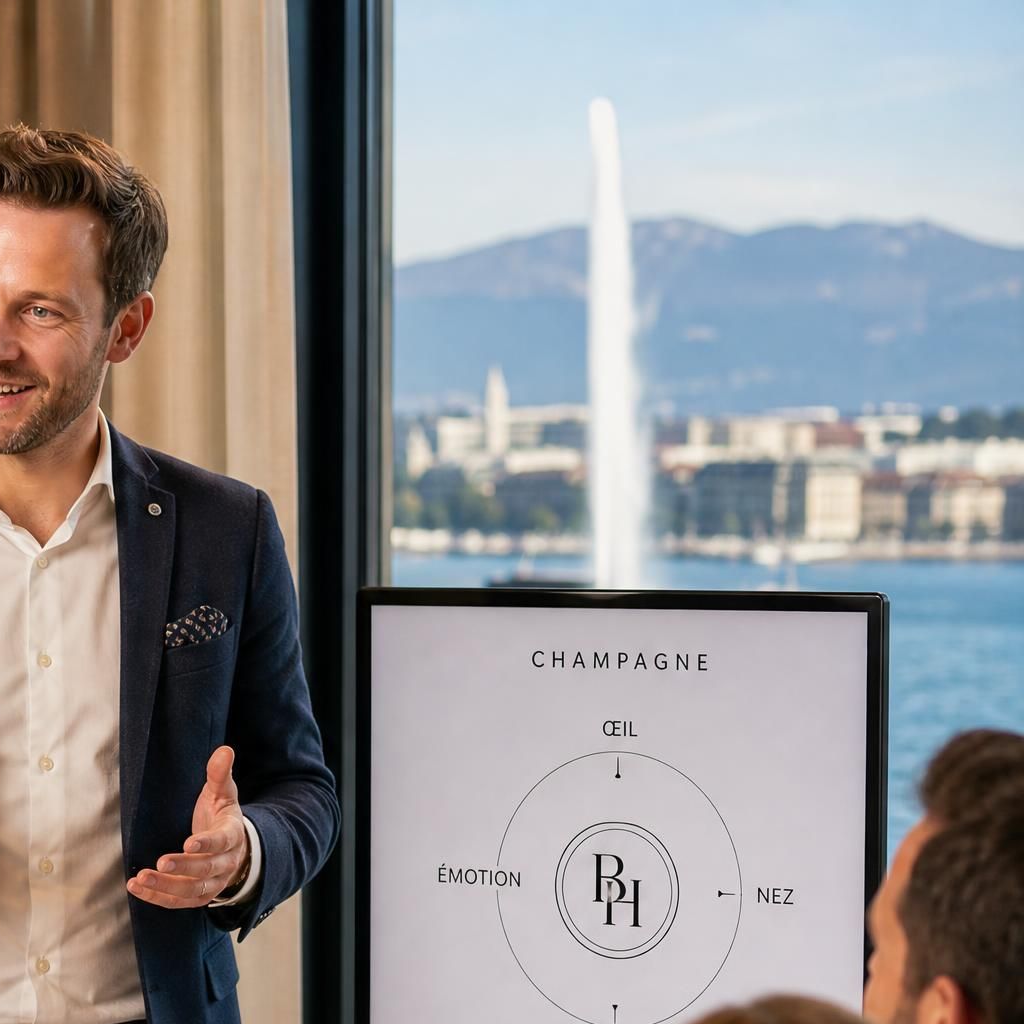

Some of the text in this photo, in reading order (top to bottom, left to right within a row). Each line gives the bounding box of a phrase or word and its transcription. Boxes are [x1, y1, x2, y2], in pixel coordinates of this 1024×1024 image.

[531, 650, 708, 672] CHAMPAGNE
[602, 720, 638, 737] ŒIL
[438, 863, 521, 888] ÉMOTION
[757, 887, 794, 905] NEZ
